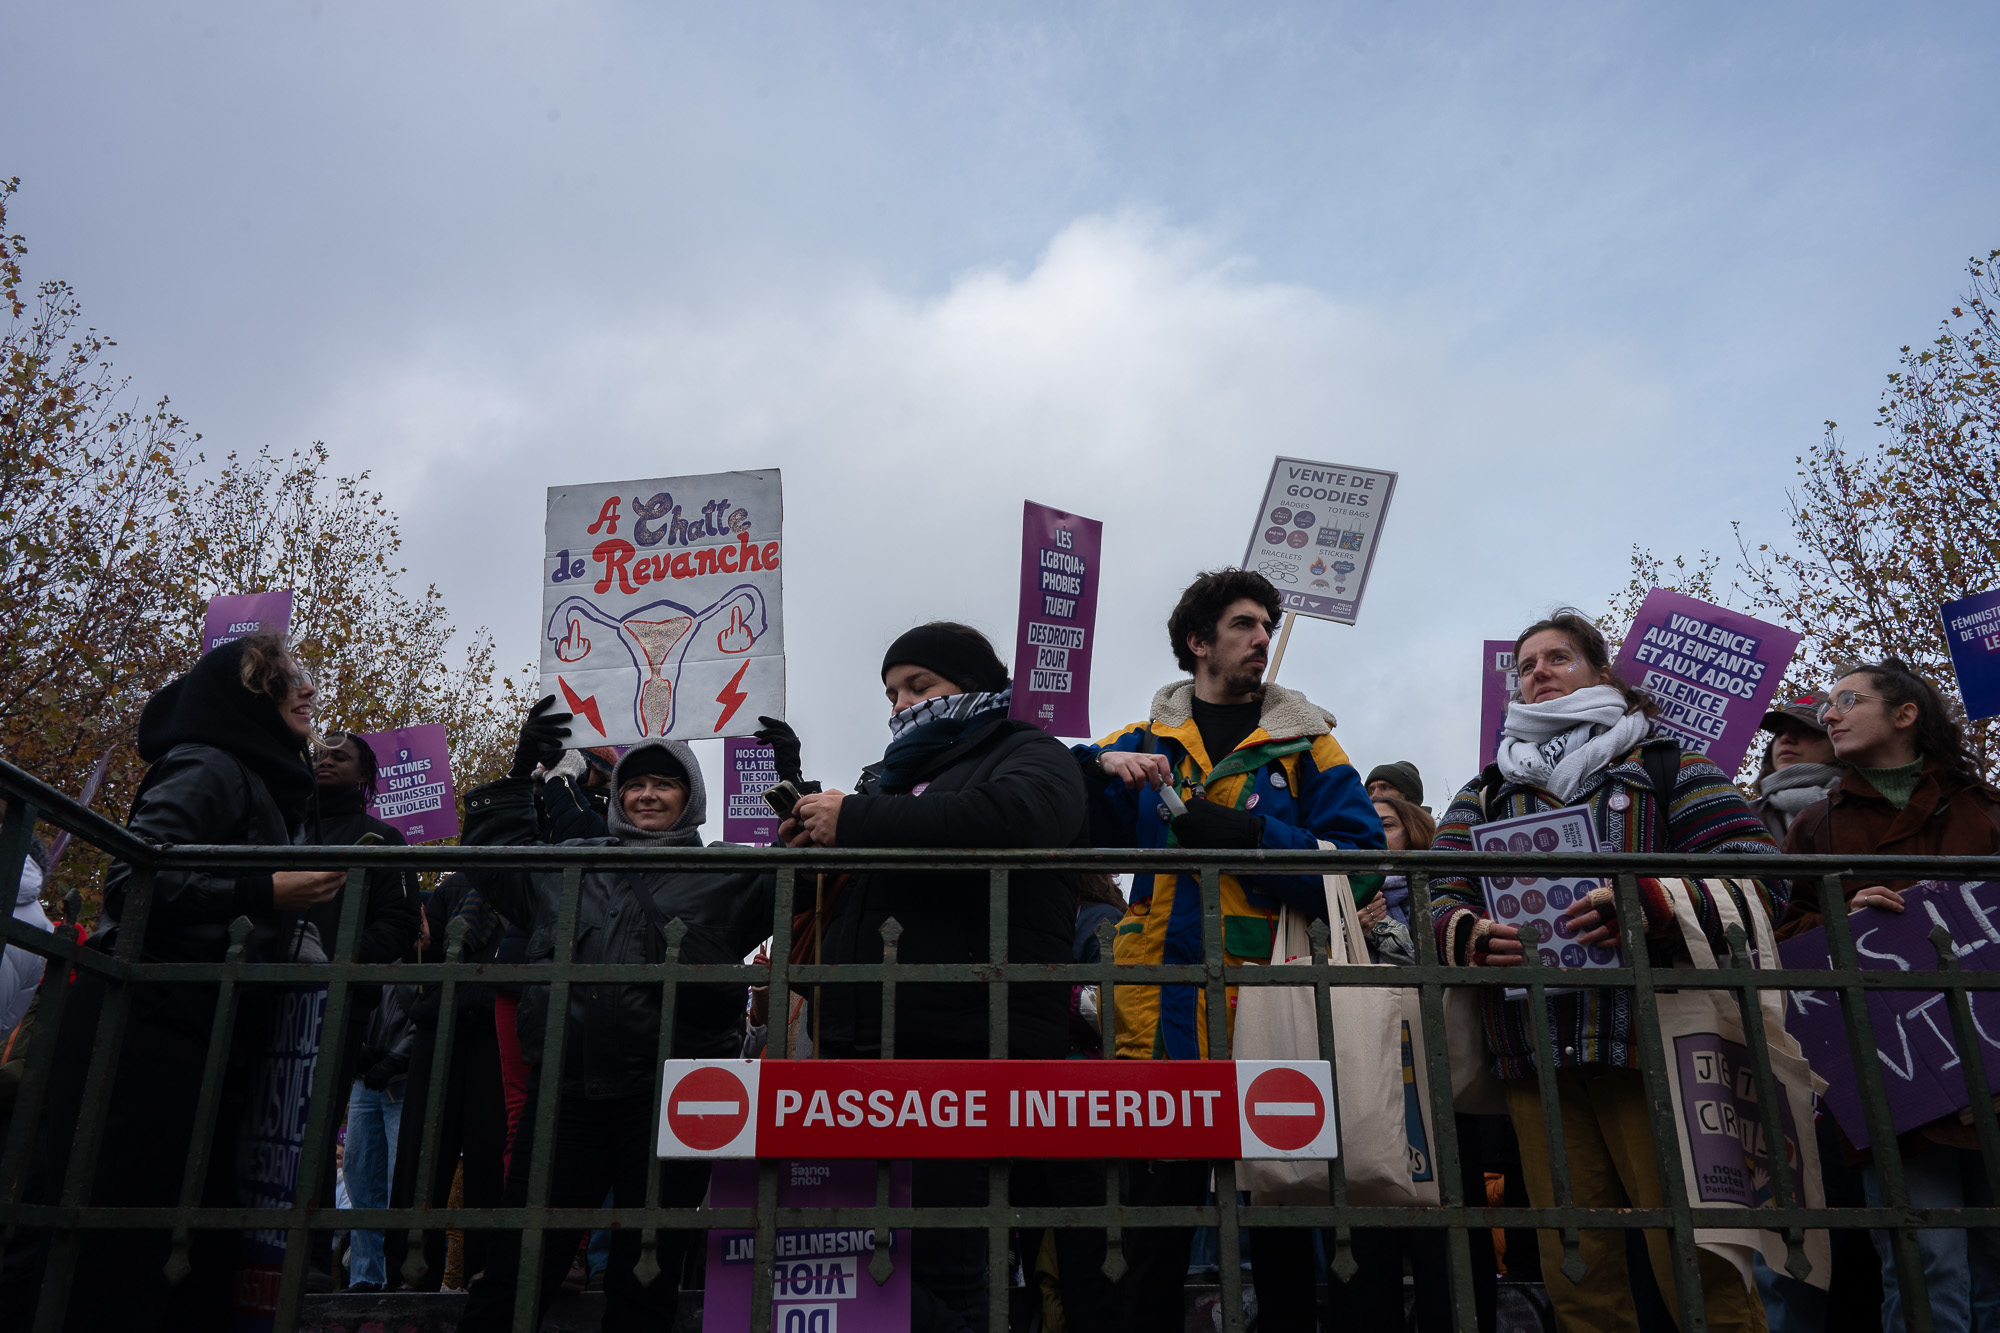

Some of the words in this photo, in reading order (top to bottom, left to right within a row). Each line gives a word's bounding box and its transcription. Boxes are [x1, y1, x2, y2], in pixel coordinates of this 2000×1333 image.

[1288, 466, 1347, 487] VENTE
[1350, 476, 1376, 490] DE
[1280, 499, 1310, 510] BADGES
[1286, 484, 1369, 507] GOODIES
[587, 496, 621, 535] A
[632, 492, 752, 547] Chatte
[1328, 506, 1348, 516] TOTE
[1348, 509, 1371, 519] BAGS
[1056, 529, 1073, 550] LES
[551, 549, 586, 583] de
[592, 532, 779, 595] Revanche
[1040, 548, 1086, 575] LGBTQIA+
[1260, 548, 1303, 561] BRACELETS
[1318, 548, 1355, 560] STICKERS
[1042, 571, 1081, 595] PHOBIES
[1045, 595, 1076, 618] TUENT
[1284, 593, 1306, 608] ICI
[228, 621, 261, 634] ASSOS
[1029, 624, 1048, 644] DES
[1047, 626, 1083, 649] DROITS
[1670, 613, 1756, 656] VIOLENCE
[1960, 628, 1975, 642] DE
[1039, 649, 1066, 668] POUR
[1643, 627, 1684, 651] AUX
[1681, 639, 1766, 681] ENFANTS
[1033, 671, 1069, 691] TOUTES
[1635, 644, 1663, 664] ET
[1660, 655, 1703, 681] AUX
[1699, 672, 1757, 700] ADOS
[1647, 673, 1724, 715] SILENCE
[1038, 709, 1054, 719] toutes
[1042, 703, 1055, 711] nous
[1647, 693, 1725, 737] OMPLICE
[1654, 725, 1706, 753] CIÉTÉ
[400, 749, 408, 761] 9
[735, 749, 755, 759] NOS
[756, 749, 775, 759] COR
[378, 758, 432, 778] VICTIMES
[736, 761, 744, 770] &
[744, 760, 757, 770] LA
[757, 760, 775, 770] TER
[389, 776, 413, 790] SUR
[412, 773, 427, 785] 10
[742, 772, 754, 782] NE
[755, 772, 780, 782] SONT
[374, 783, 445, 806] CONNAISSENT
[743, 784, 762, 793] PAS
[382, 806, 397, 817] LE
[396, 797, 440, 815] VIOLEUR
[732, 796, 766, 805] TERRIT
[730, 807, 742, 816] DE
[743, 807, 776, 817] CONQU
[1562, 825, 1571, 843] nous
[1569, 823, 1578, 848] toutes
[775, 1089, 987, 1128] PASSAGE
[1008, 1089, 1221, 1128] INTERDIT
[790, 1166, 831, 1178] toutes
[1703, 1173, 1744, 1188] toutes
[1713, 1165, 1743, 1178] nous
[790, 1176, 822, 1187] nous
[1705, 1185, 1746, 1198] ParisNord
[725, 1229, 892, 1261] ONSENTENT
[774, 1263, 847, 1296] VIOL
